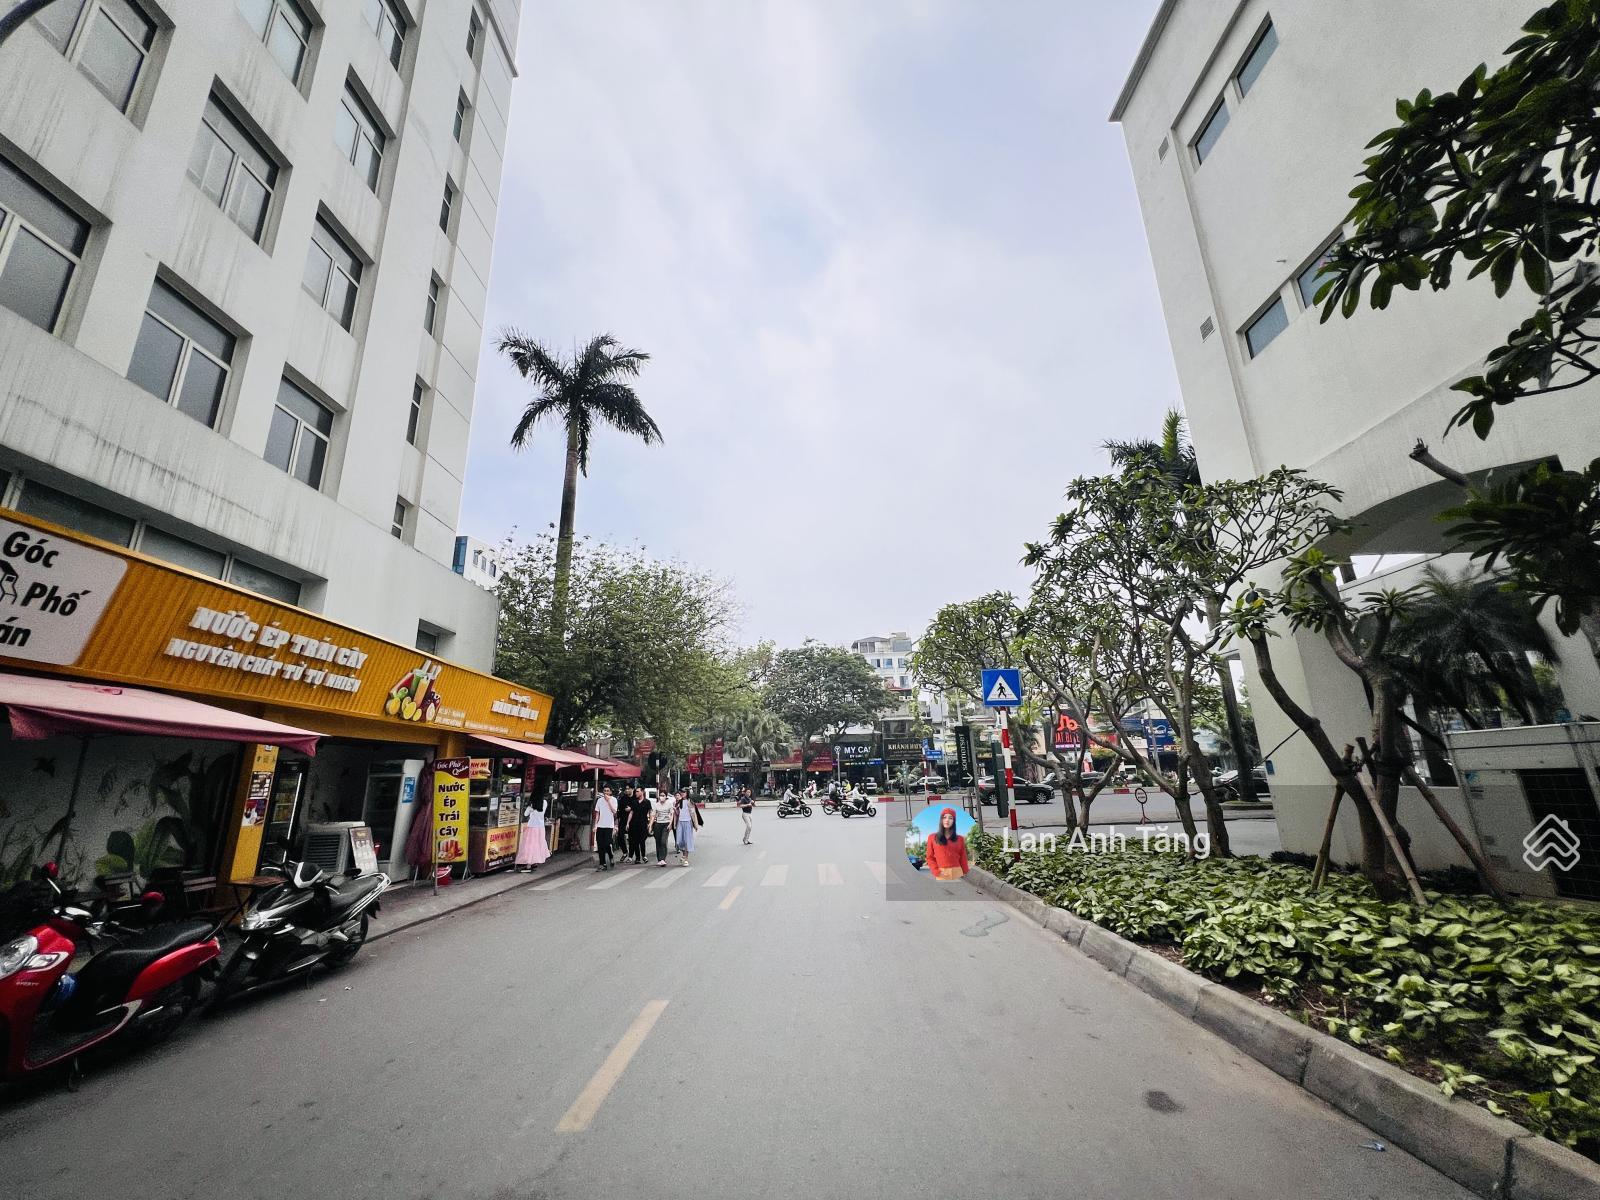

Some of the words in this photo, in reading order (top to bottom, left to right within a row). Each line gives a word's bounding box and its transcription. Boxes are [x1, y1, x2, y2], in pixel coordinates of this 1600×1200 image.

[3, 531, 59, 568] Góc
[20, 581, 92, 616] Phố
[188, 606, 260, 642] NƯỚC
[257, 621, 291, 649] ÉP
[290, 636, 338, 662] TRÁI
[334, 647, 368, 669] CÂY
[164, 638, 244, 669] NGUYÊN
[325, 674, 362, 693] NHIÊN
[844, 746, 856, 754] MY
[438, 781, 465, 793] Nước
[443, 795, 456, 808] Ép
[439, 810, 460, 821] Trái
